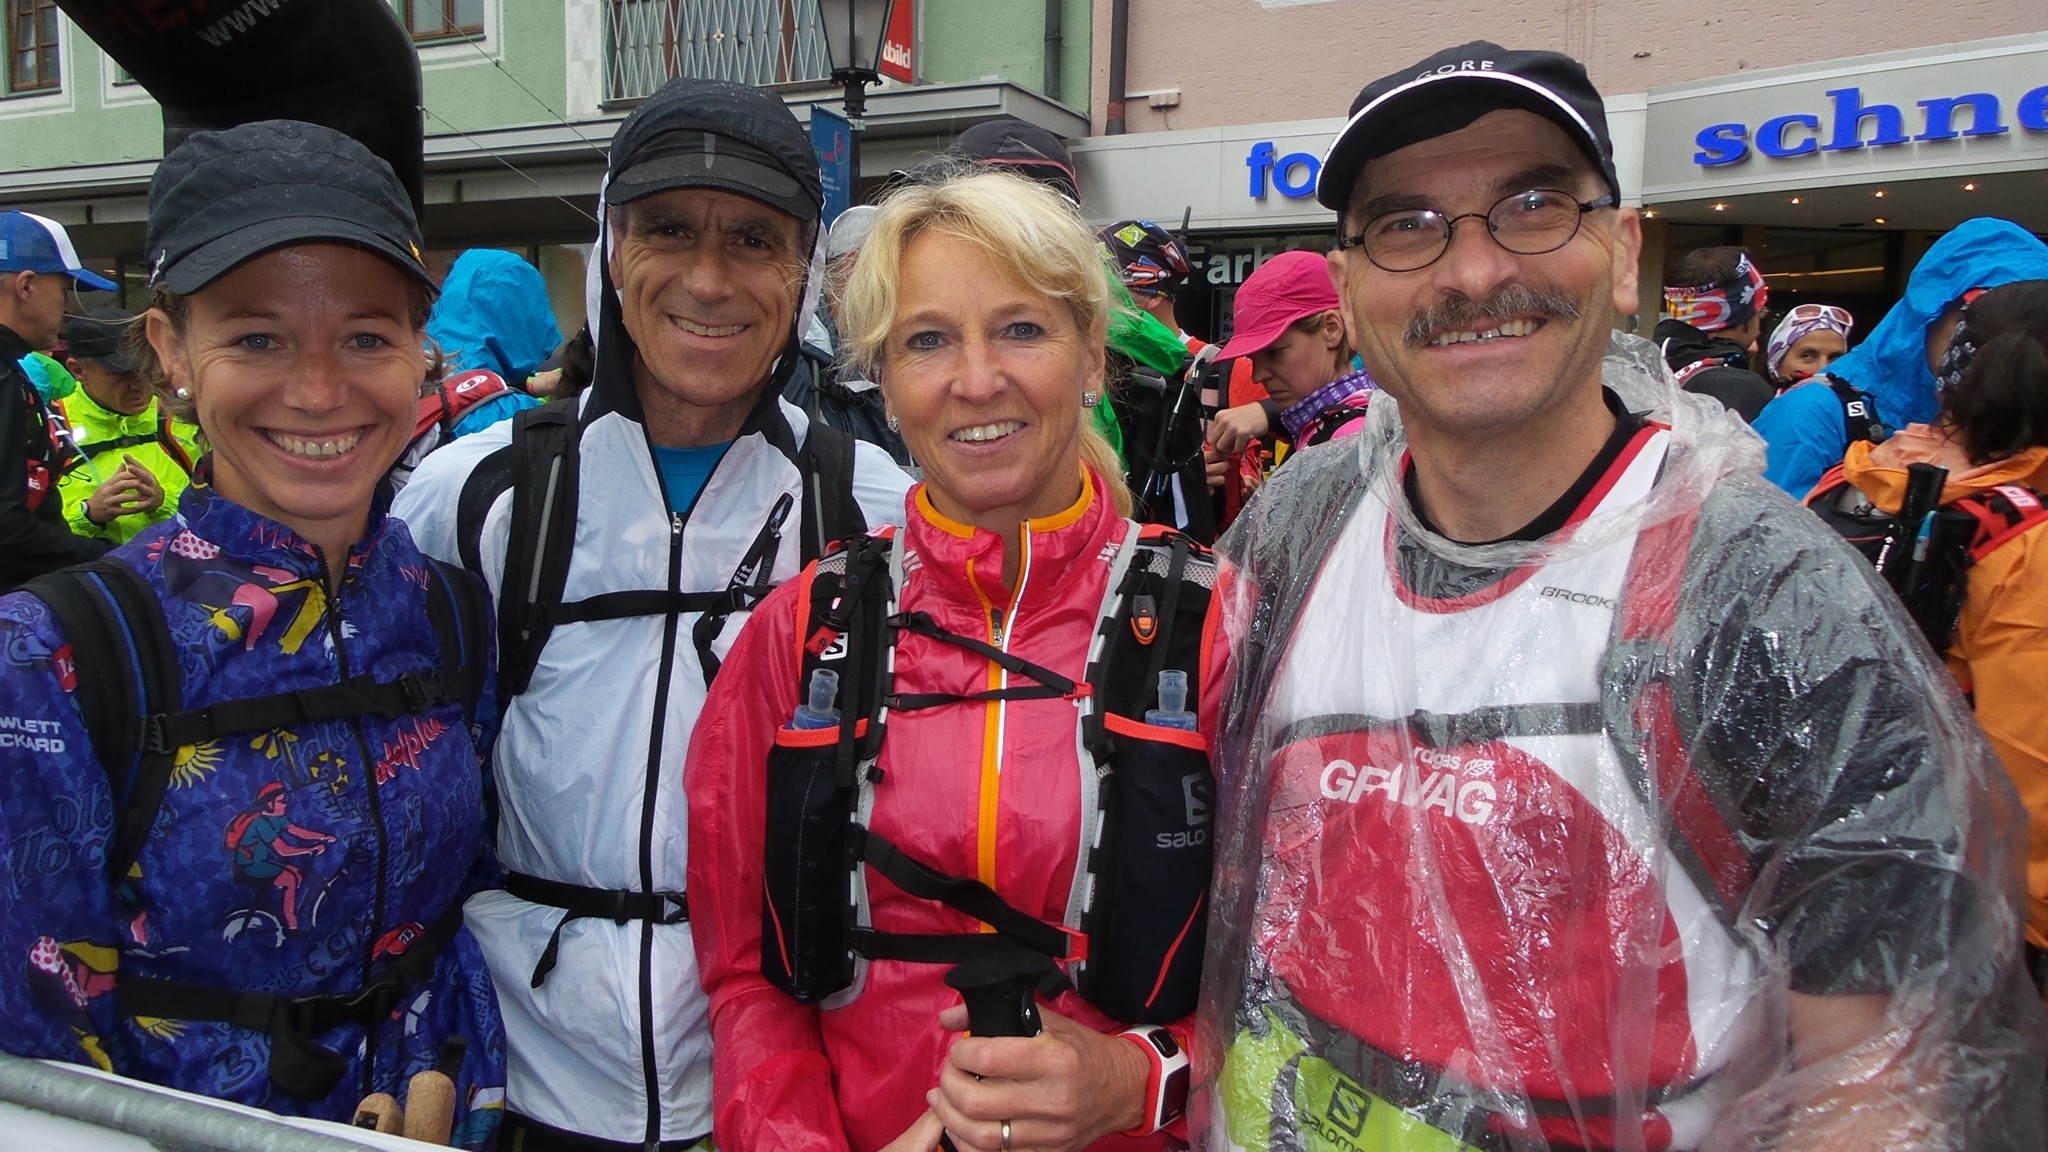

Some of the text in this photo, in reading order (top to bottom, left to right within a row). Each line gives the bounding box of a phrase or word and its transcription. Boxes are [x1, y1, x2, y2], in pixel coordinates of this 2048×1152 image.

[1415, 60, 1494, 81] GORE
[1541, 586, 1615, 611] BROOK
[1413, 746, 1462, 771] rdgas
